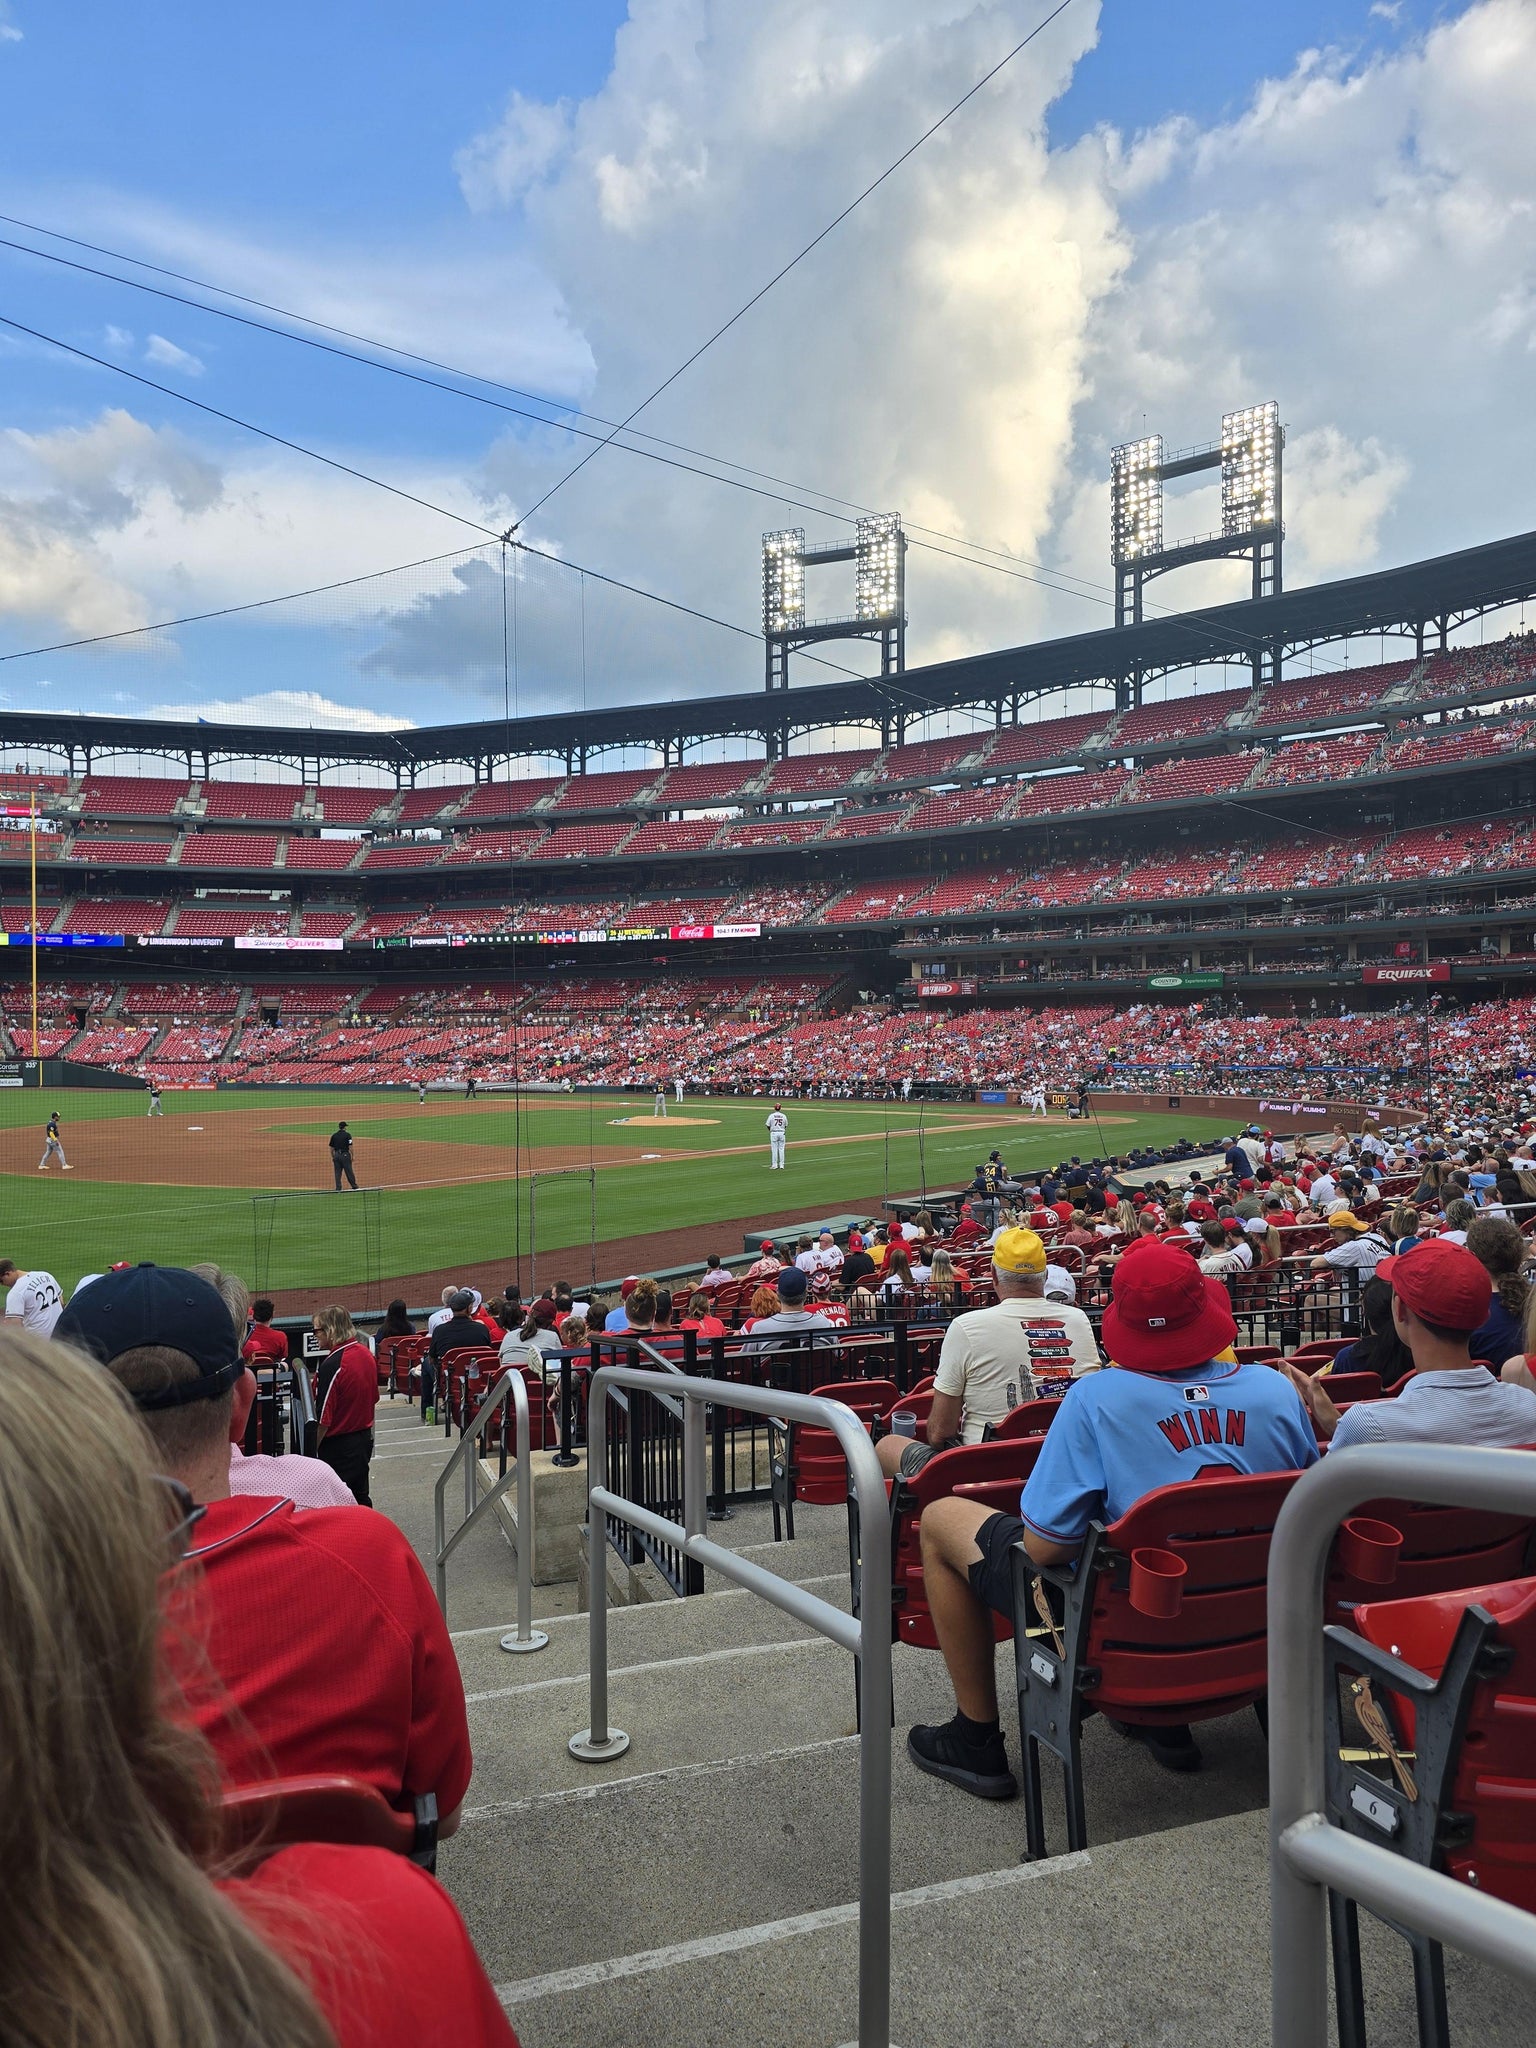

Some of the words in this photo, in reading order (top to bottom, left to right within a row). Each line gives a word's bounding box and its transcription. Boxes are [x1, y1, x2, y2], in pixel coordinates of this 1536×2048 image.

[678, 926, 705, 938] Coca-Cola
[149, 938, 190, 946] LINDENWOOD
[190, 938, 224, 946] UNIVERSITY
[1377, 968, 1433, 982] EQUIFAX
[774, 1118, 783, 1126] 75
[36, 1285, 58, 1311] 22
[1156, 1408, 1246, 1454] WINN
[1040, 1662, 1046, 1674] 5
[1369, 1801, 1378, 1816] 6
